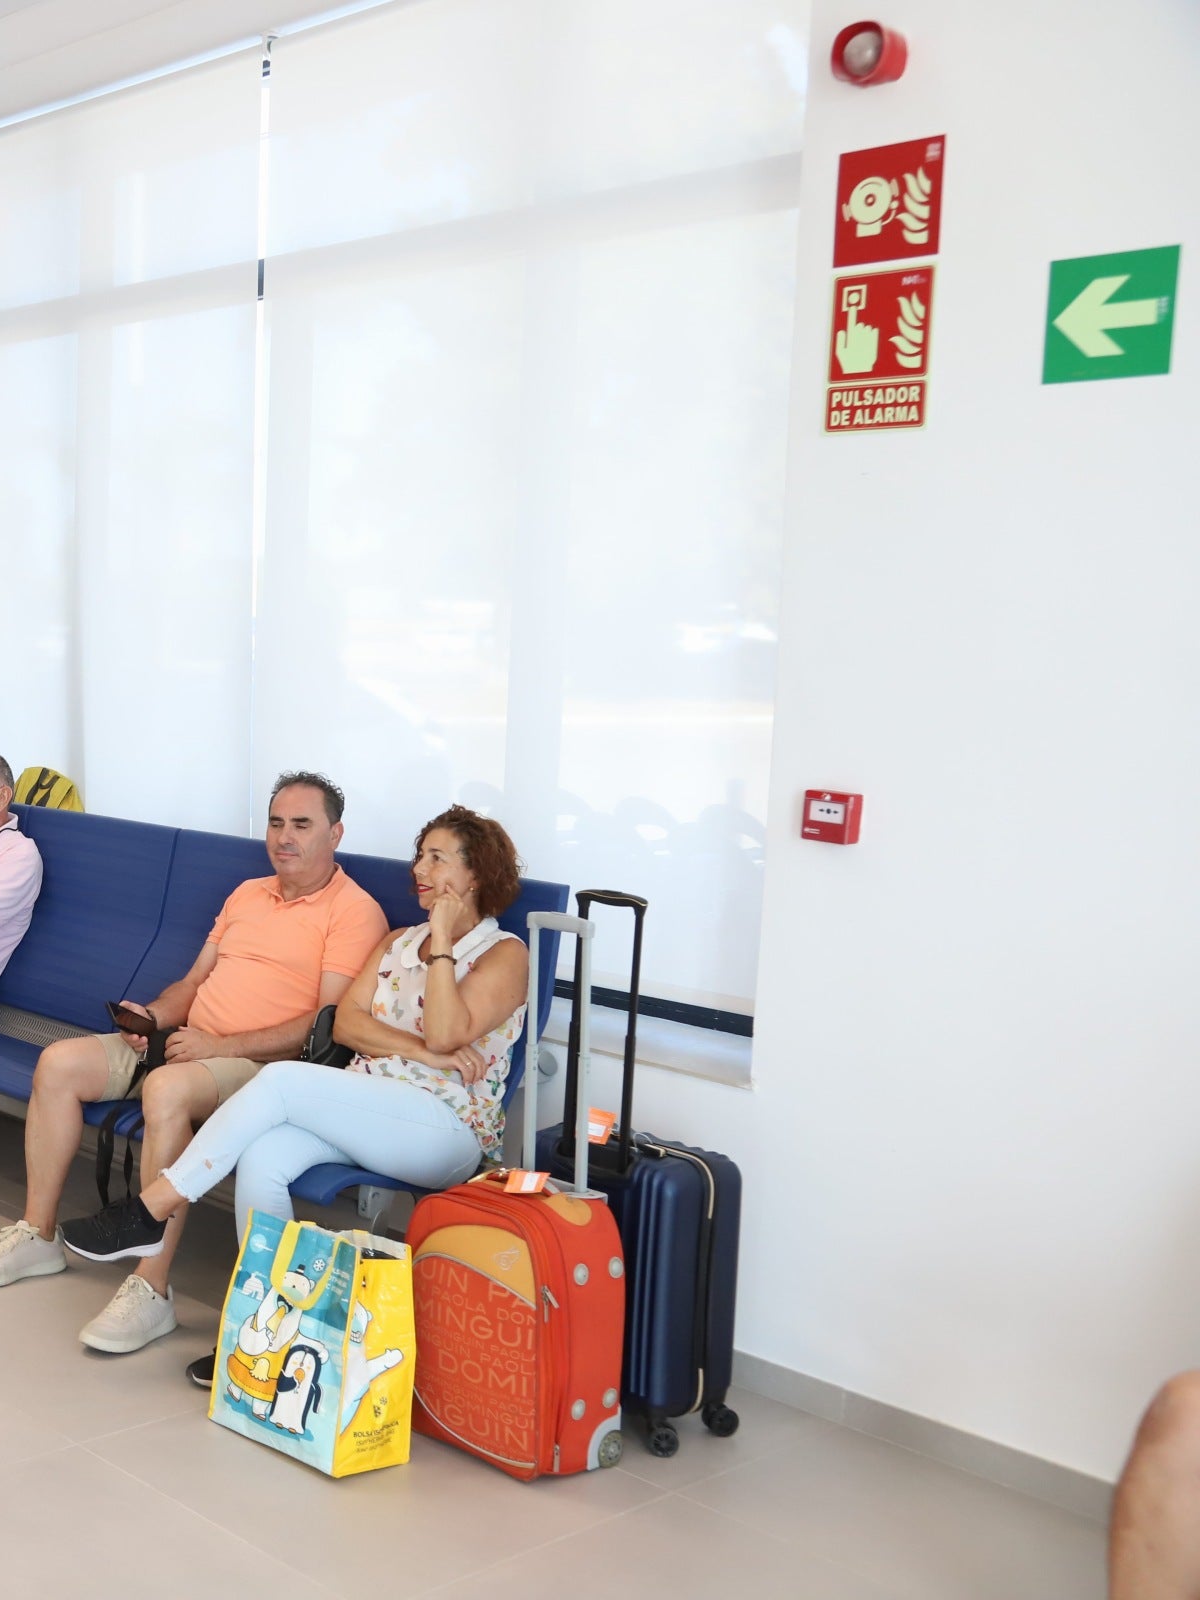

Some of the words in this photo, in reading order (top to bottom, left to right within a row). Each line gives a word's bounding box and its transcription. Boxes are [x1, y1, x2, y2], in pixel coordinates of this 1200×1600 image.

[832, 385, 920, 407] PULSADOR
[830, 410, 851, 426] DE
[853, 405, 919, 425] ALARMA
[432, 1285, 486, 1314] PAOLA
[416, 1298, 533, 1350] MINGUI
